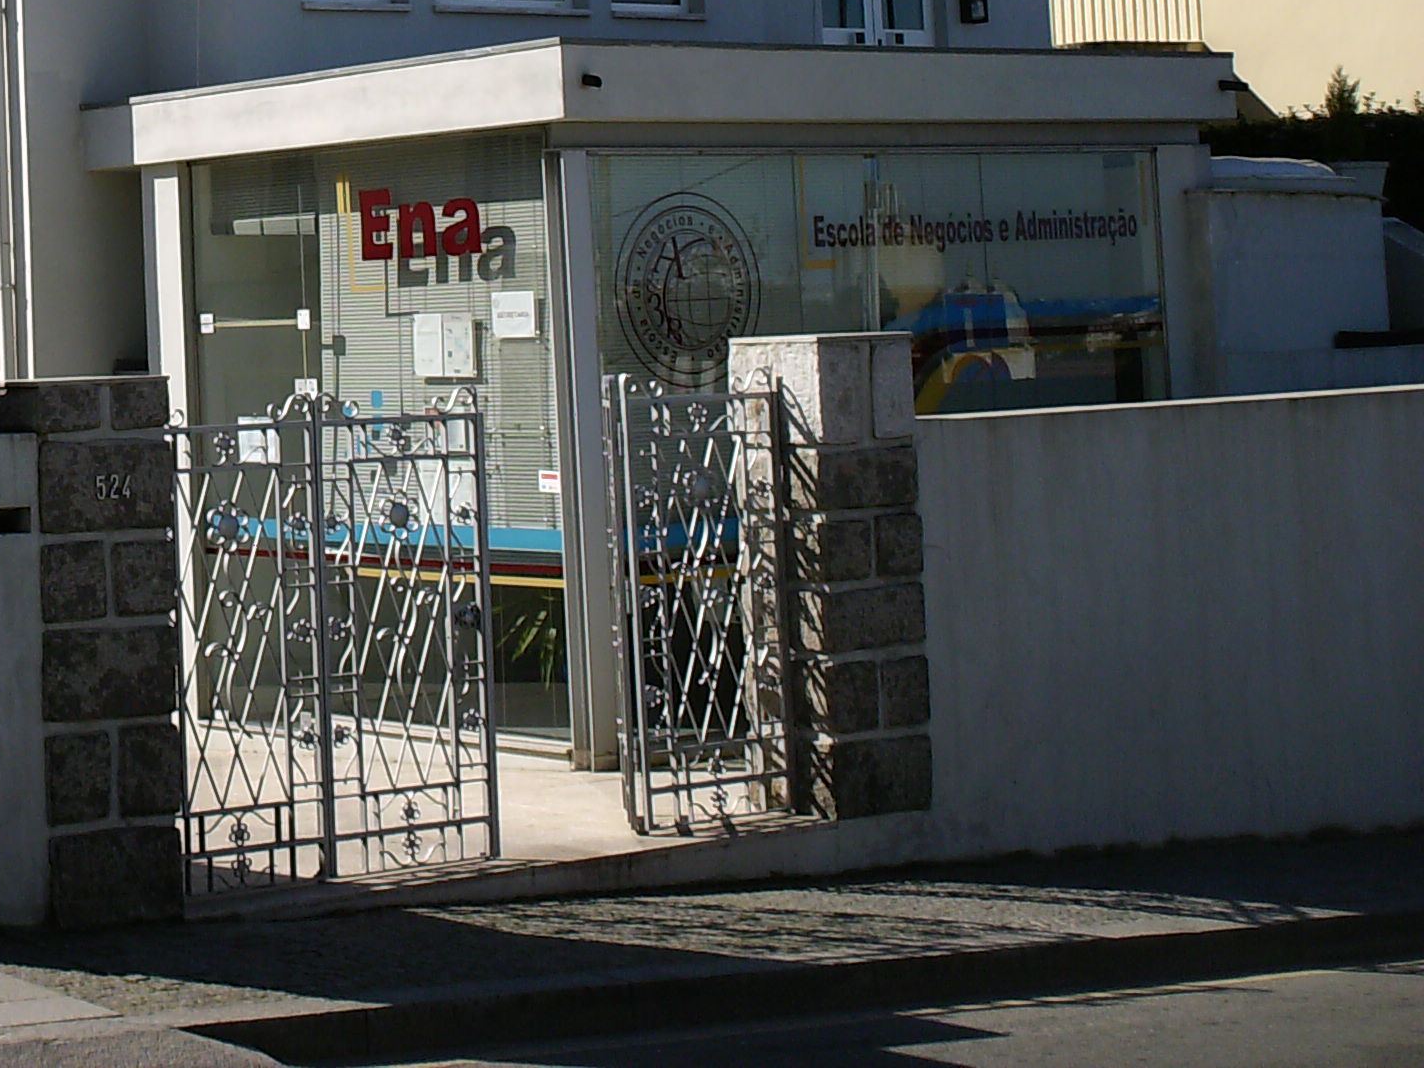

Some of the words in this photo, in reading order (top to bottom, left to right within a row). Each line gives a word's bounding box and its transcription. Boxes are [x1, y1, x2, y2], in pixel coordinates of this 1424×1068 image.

[359, 187, 482, 261] Ena
[813, 215, 876, 248] Escola
[883, 214, 904, 246] de
[909, 212, 993, 253] Negócios
[999, 221, 1008, 242] e
[1015, 208, 1137, 246] Administração
[96, 475, 131, 500] 524
